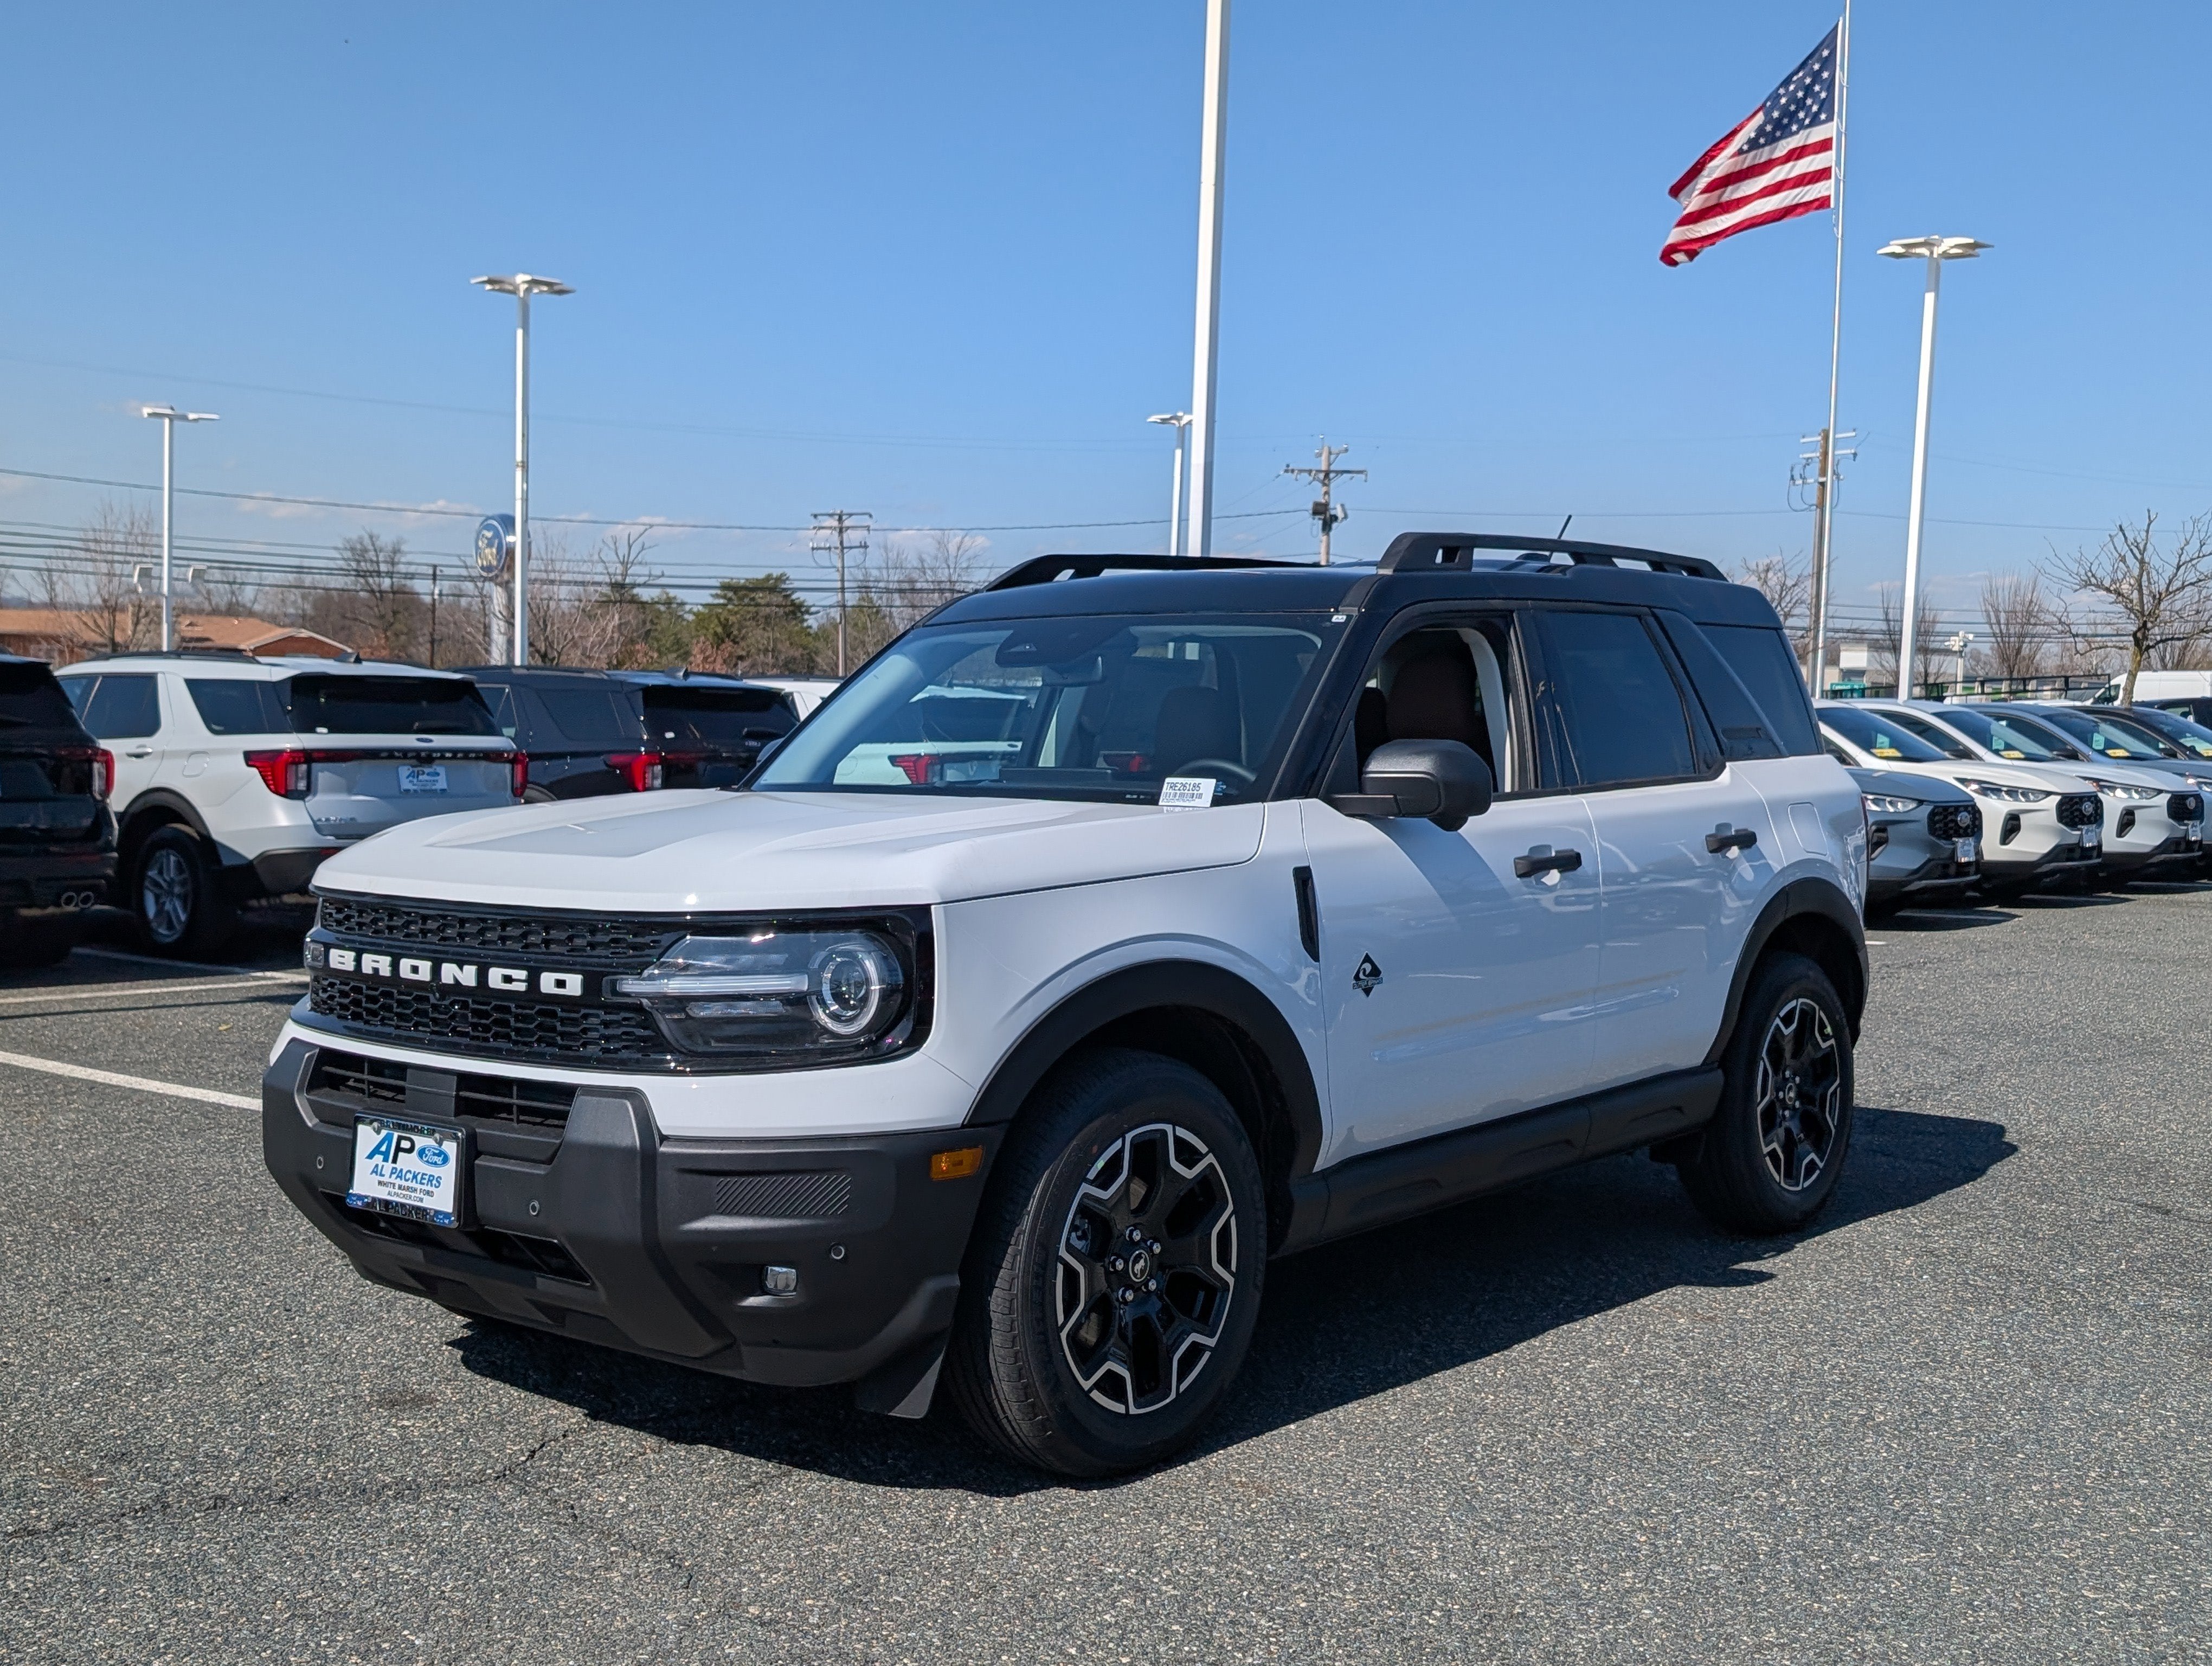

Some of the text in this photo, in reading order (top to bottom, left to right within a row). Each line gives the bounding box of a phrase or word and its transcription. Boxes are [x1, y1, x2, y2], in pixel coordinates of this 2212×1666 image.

[1166, 782, 1201, 792] TRE26185
[329, 948, 584, 996] BRONCO
[365, 1132, 415, 1164] AP
[422, 1147, 443, 1164] Ford
[370, 1164, 442, 1189] AL PACKERS
[377, 1180, 435, 1198] WHITE MARSH FORD
[387, 1190, 424, 1203] ALPACKER.COM
